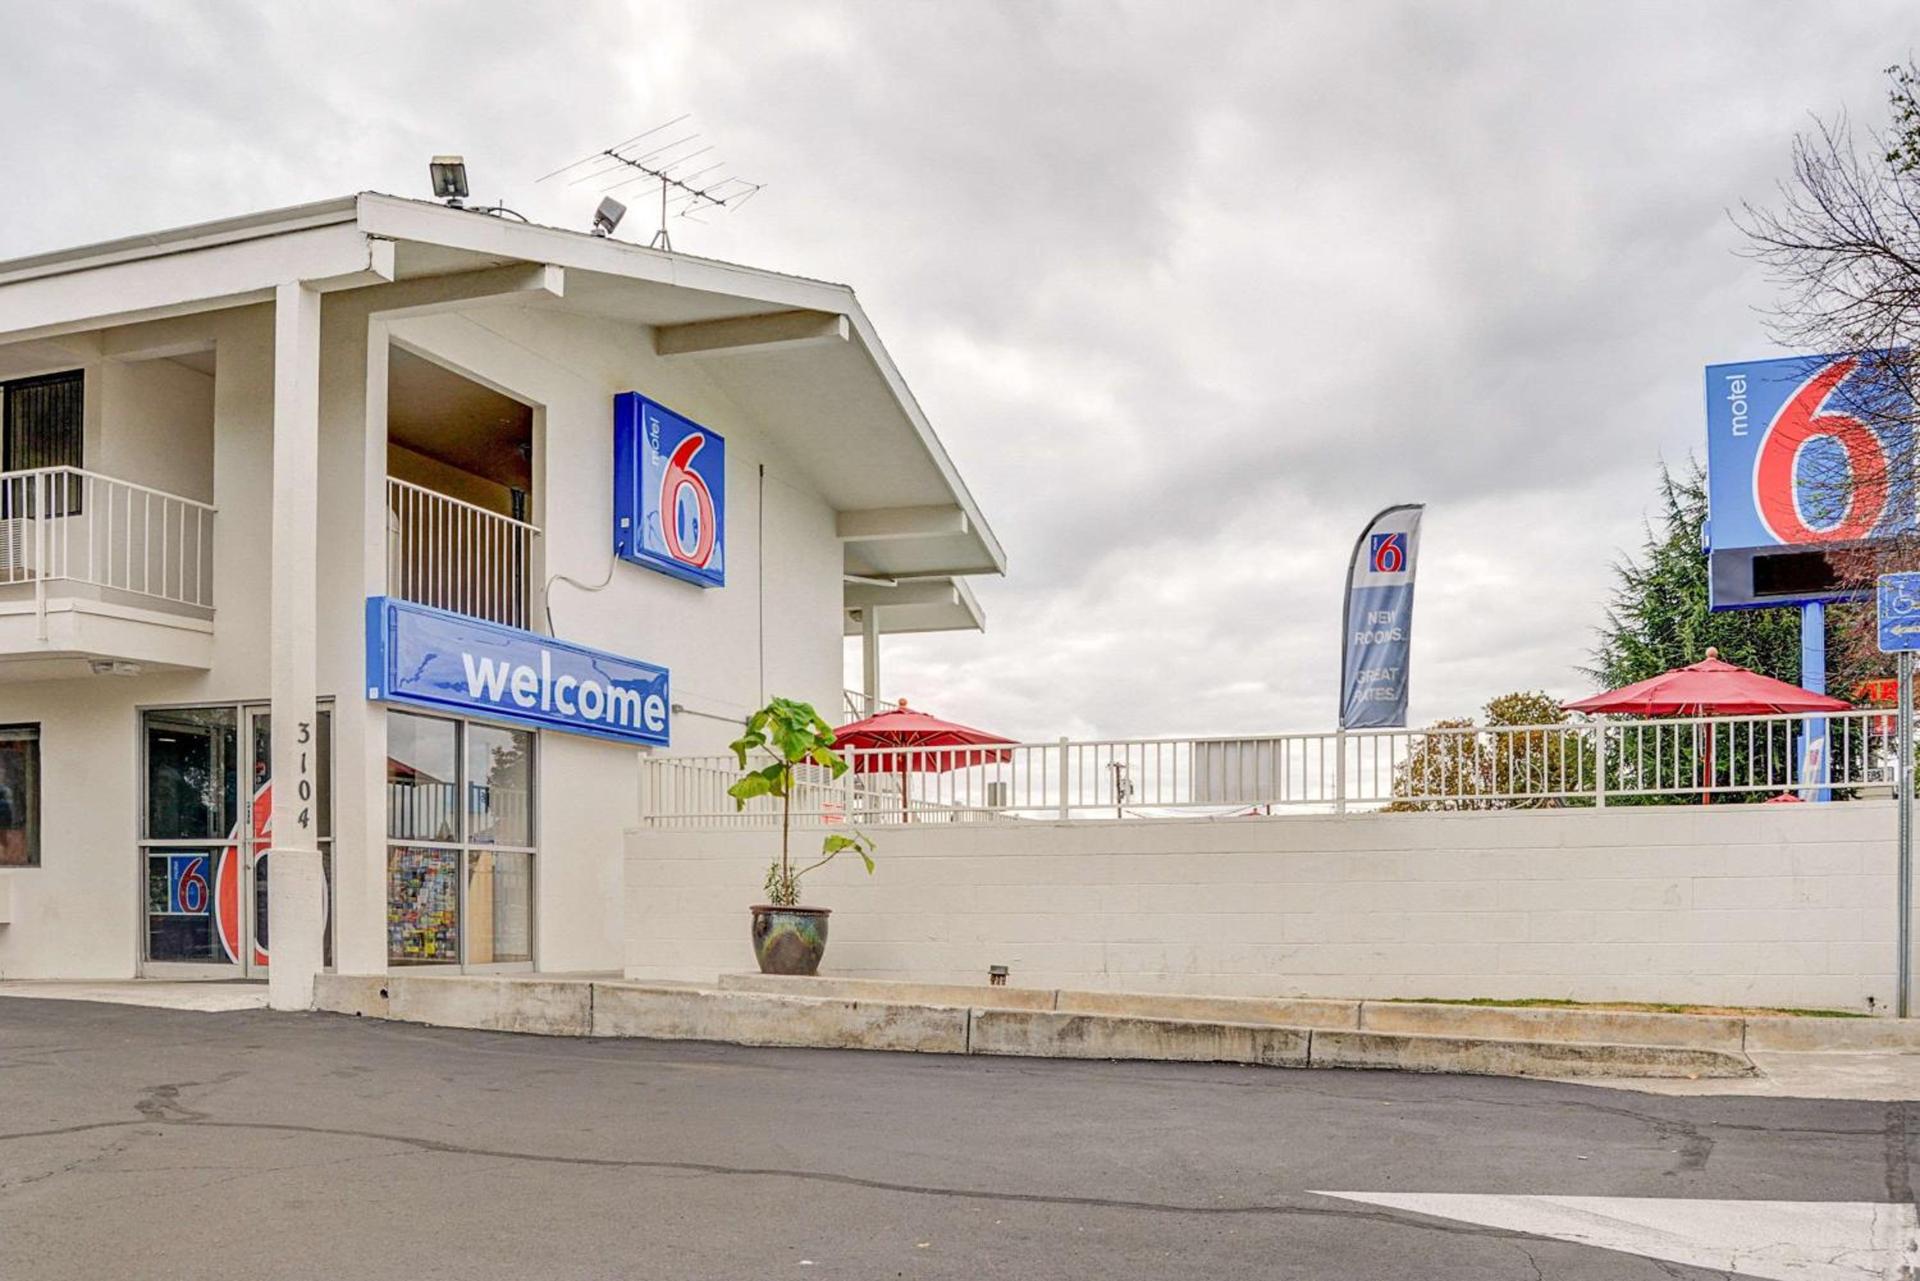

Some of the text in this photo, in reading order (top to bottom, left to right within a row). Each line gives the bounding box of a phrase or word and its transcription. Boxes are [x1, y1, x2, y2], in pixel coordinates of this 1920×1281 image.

[1726, 374, 1748, 437] motel
[650, 418, 661, 467] motel
[1752, 356, 1889, 545] 6
[660, 432, 716, 569] 6
[1376, 533, 1403, 573] 6
[462, 650, 666, 732] welcome
[297, 721, 311, 830] 3104
[178, 857, 209, 914] 6
